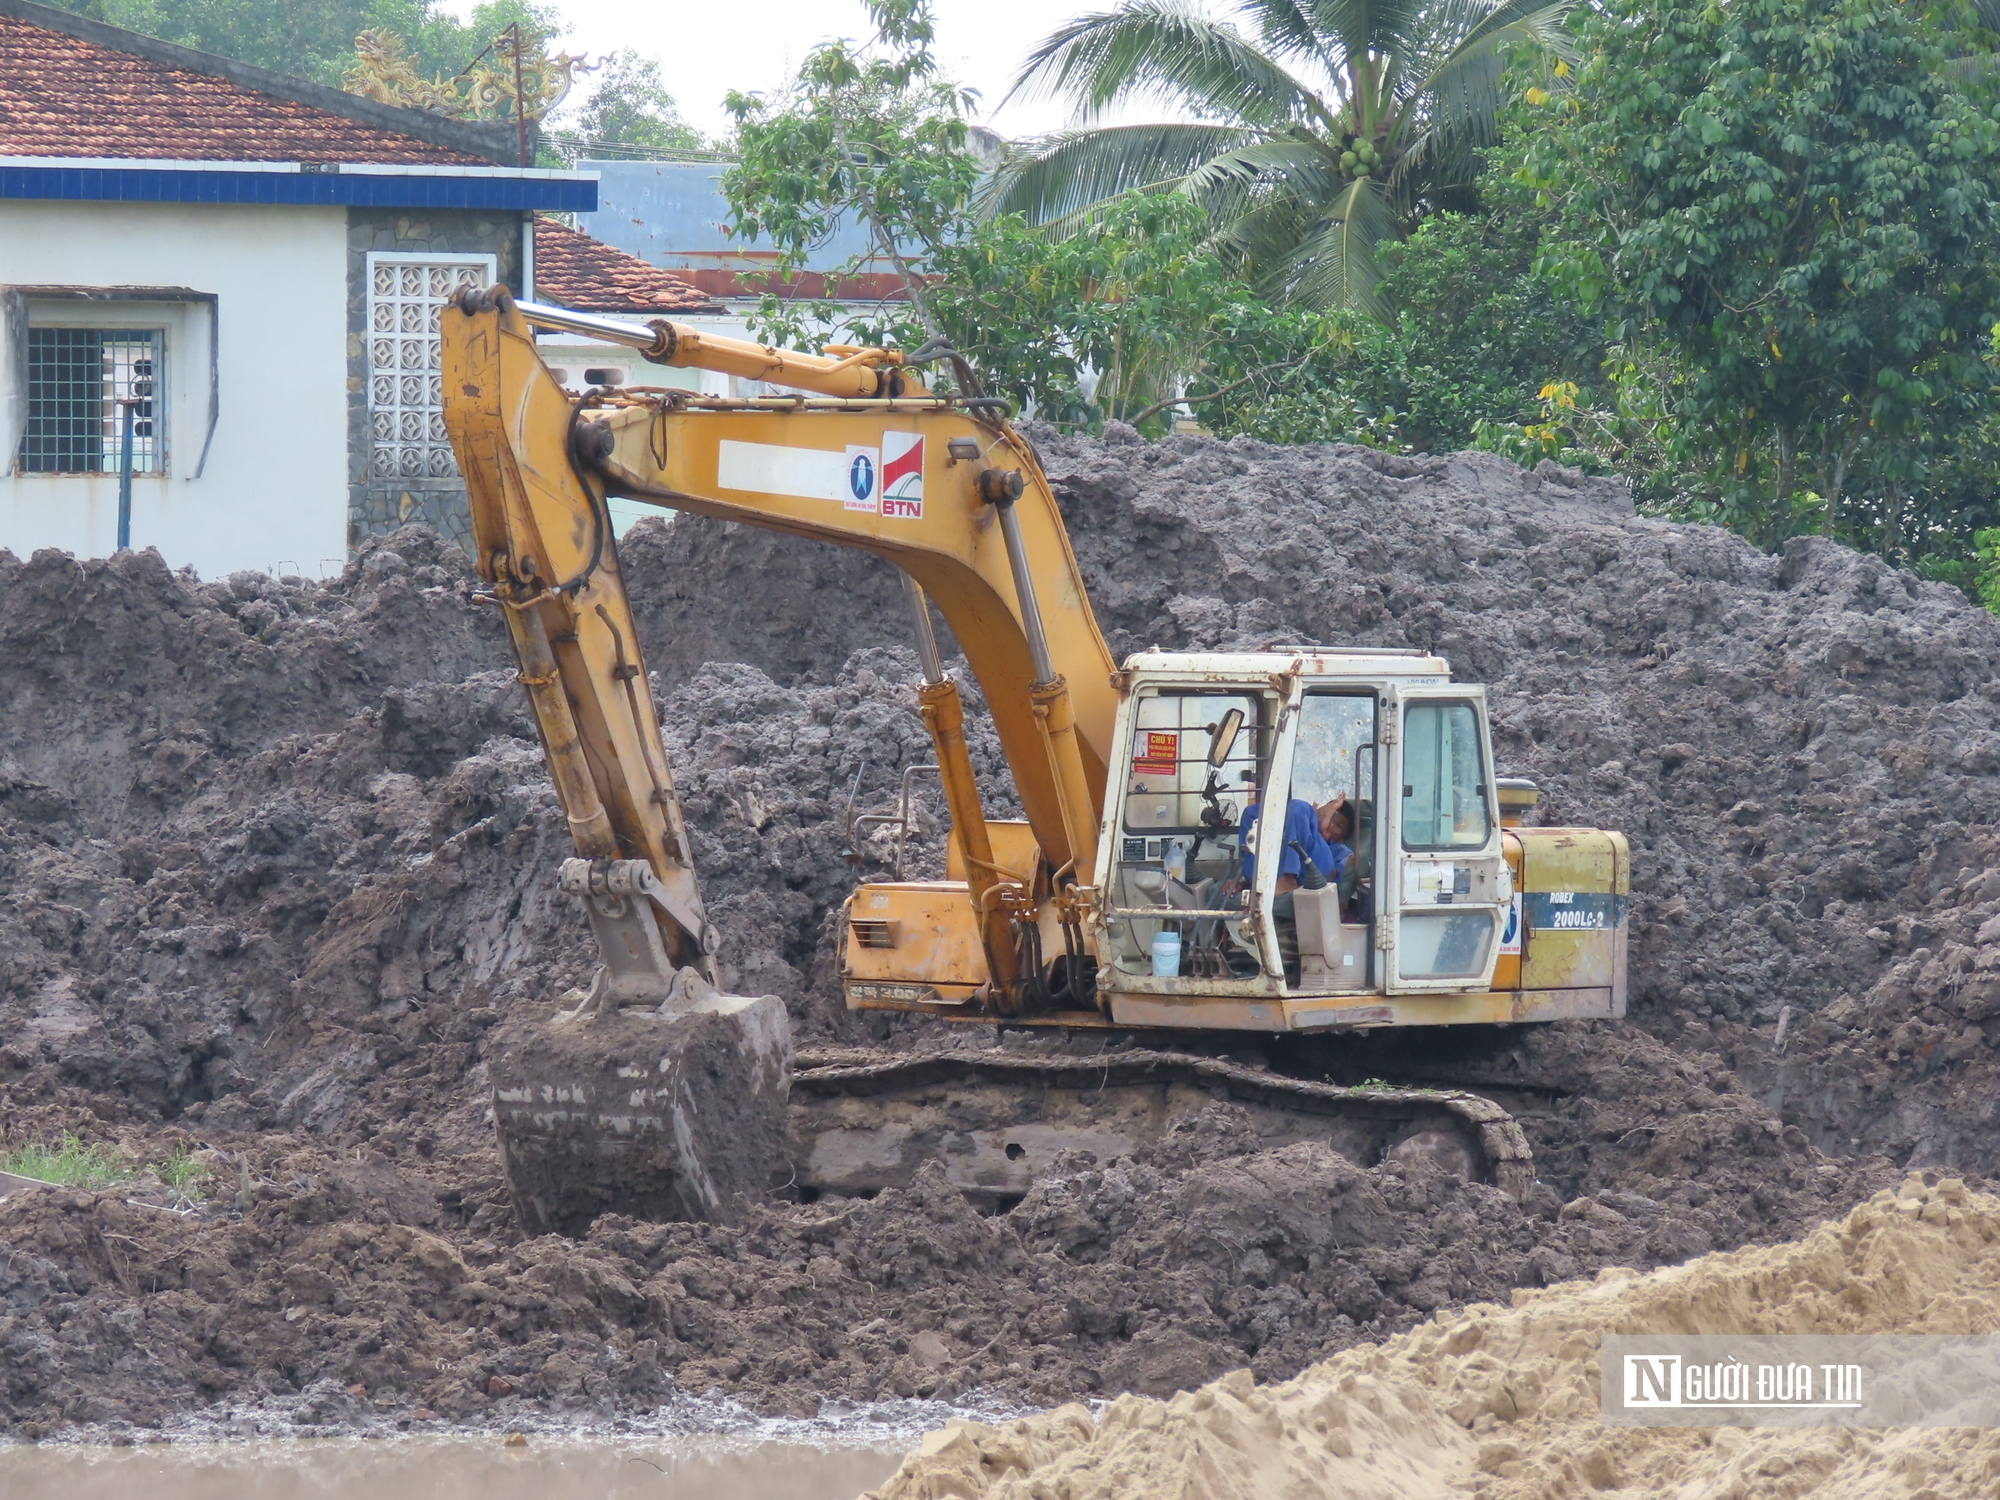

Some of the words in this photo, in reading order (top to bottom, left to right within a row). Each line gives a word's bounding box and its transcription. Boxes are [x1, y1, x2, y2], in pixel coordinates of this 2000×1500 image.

[883, 500, 921, 517] BTN
[1150, 734, 1166, 744] CHÚ
[1549, 892, 1575, 904] ROBEX
[1553, 910, 1604, 928] 2000LC-2
